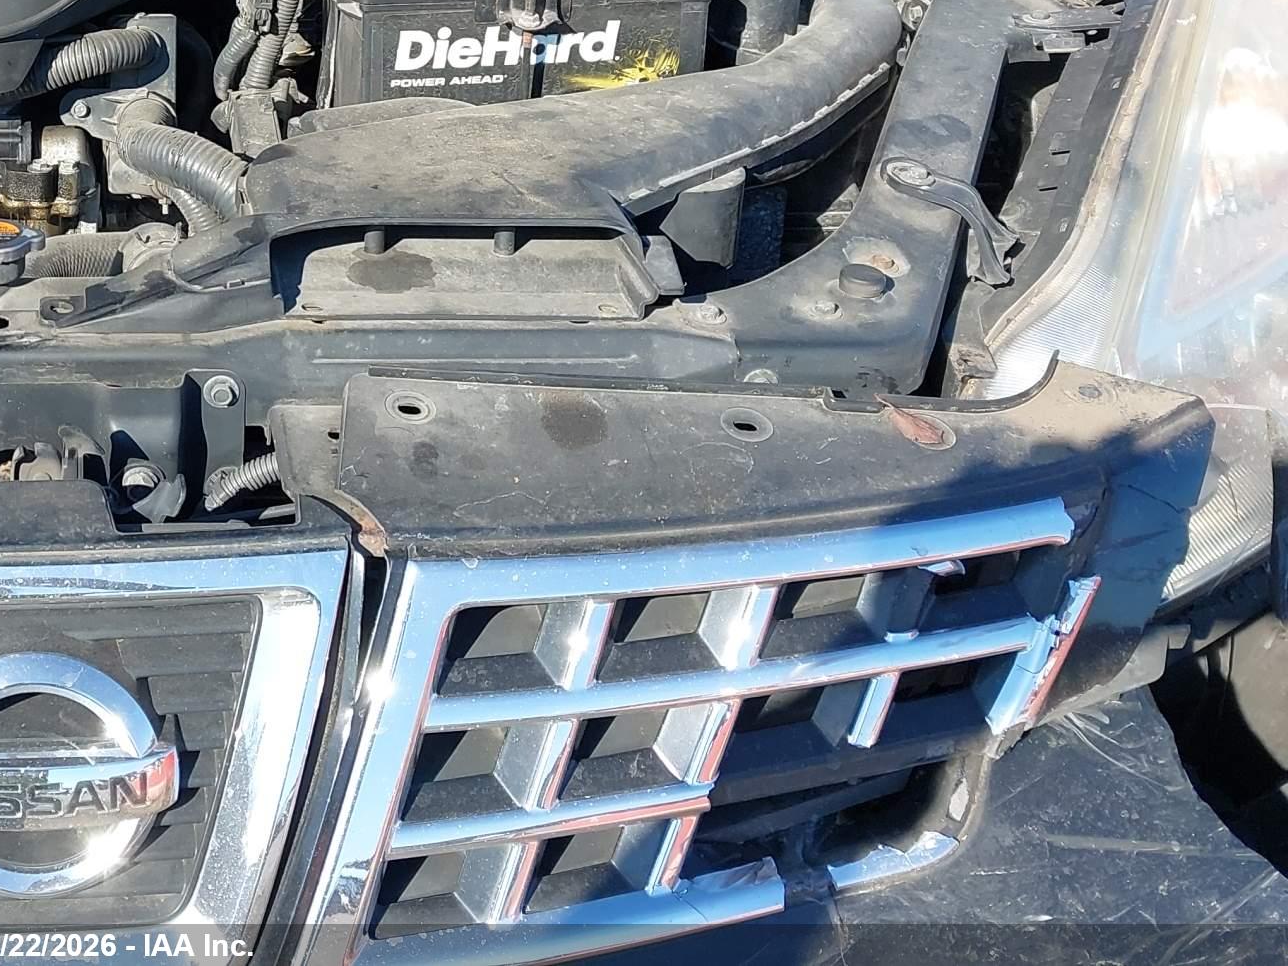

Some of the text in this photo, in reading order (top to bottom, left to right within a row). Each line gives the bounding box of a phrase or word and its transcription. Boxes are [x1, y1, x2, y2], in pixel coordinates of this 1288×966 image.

[394, 19, 621, 71] DieHard
[390, 75, 505, 88] POWER AHEAD
